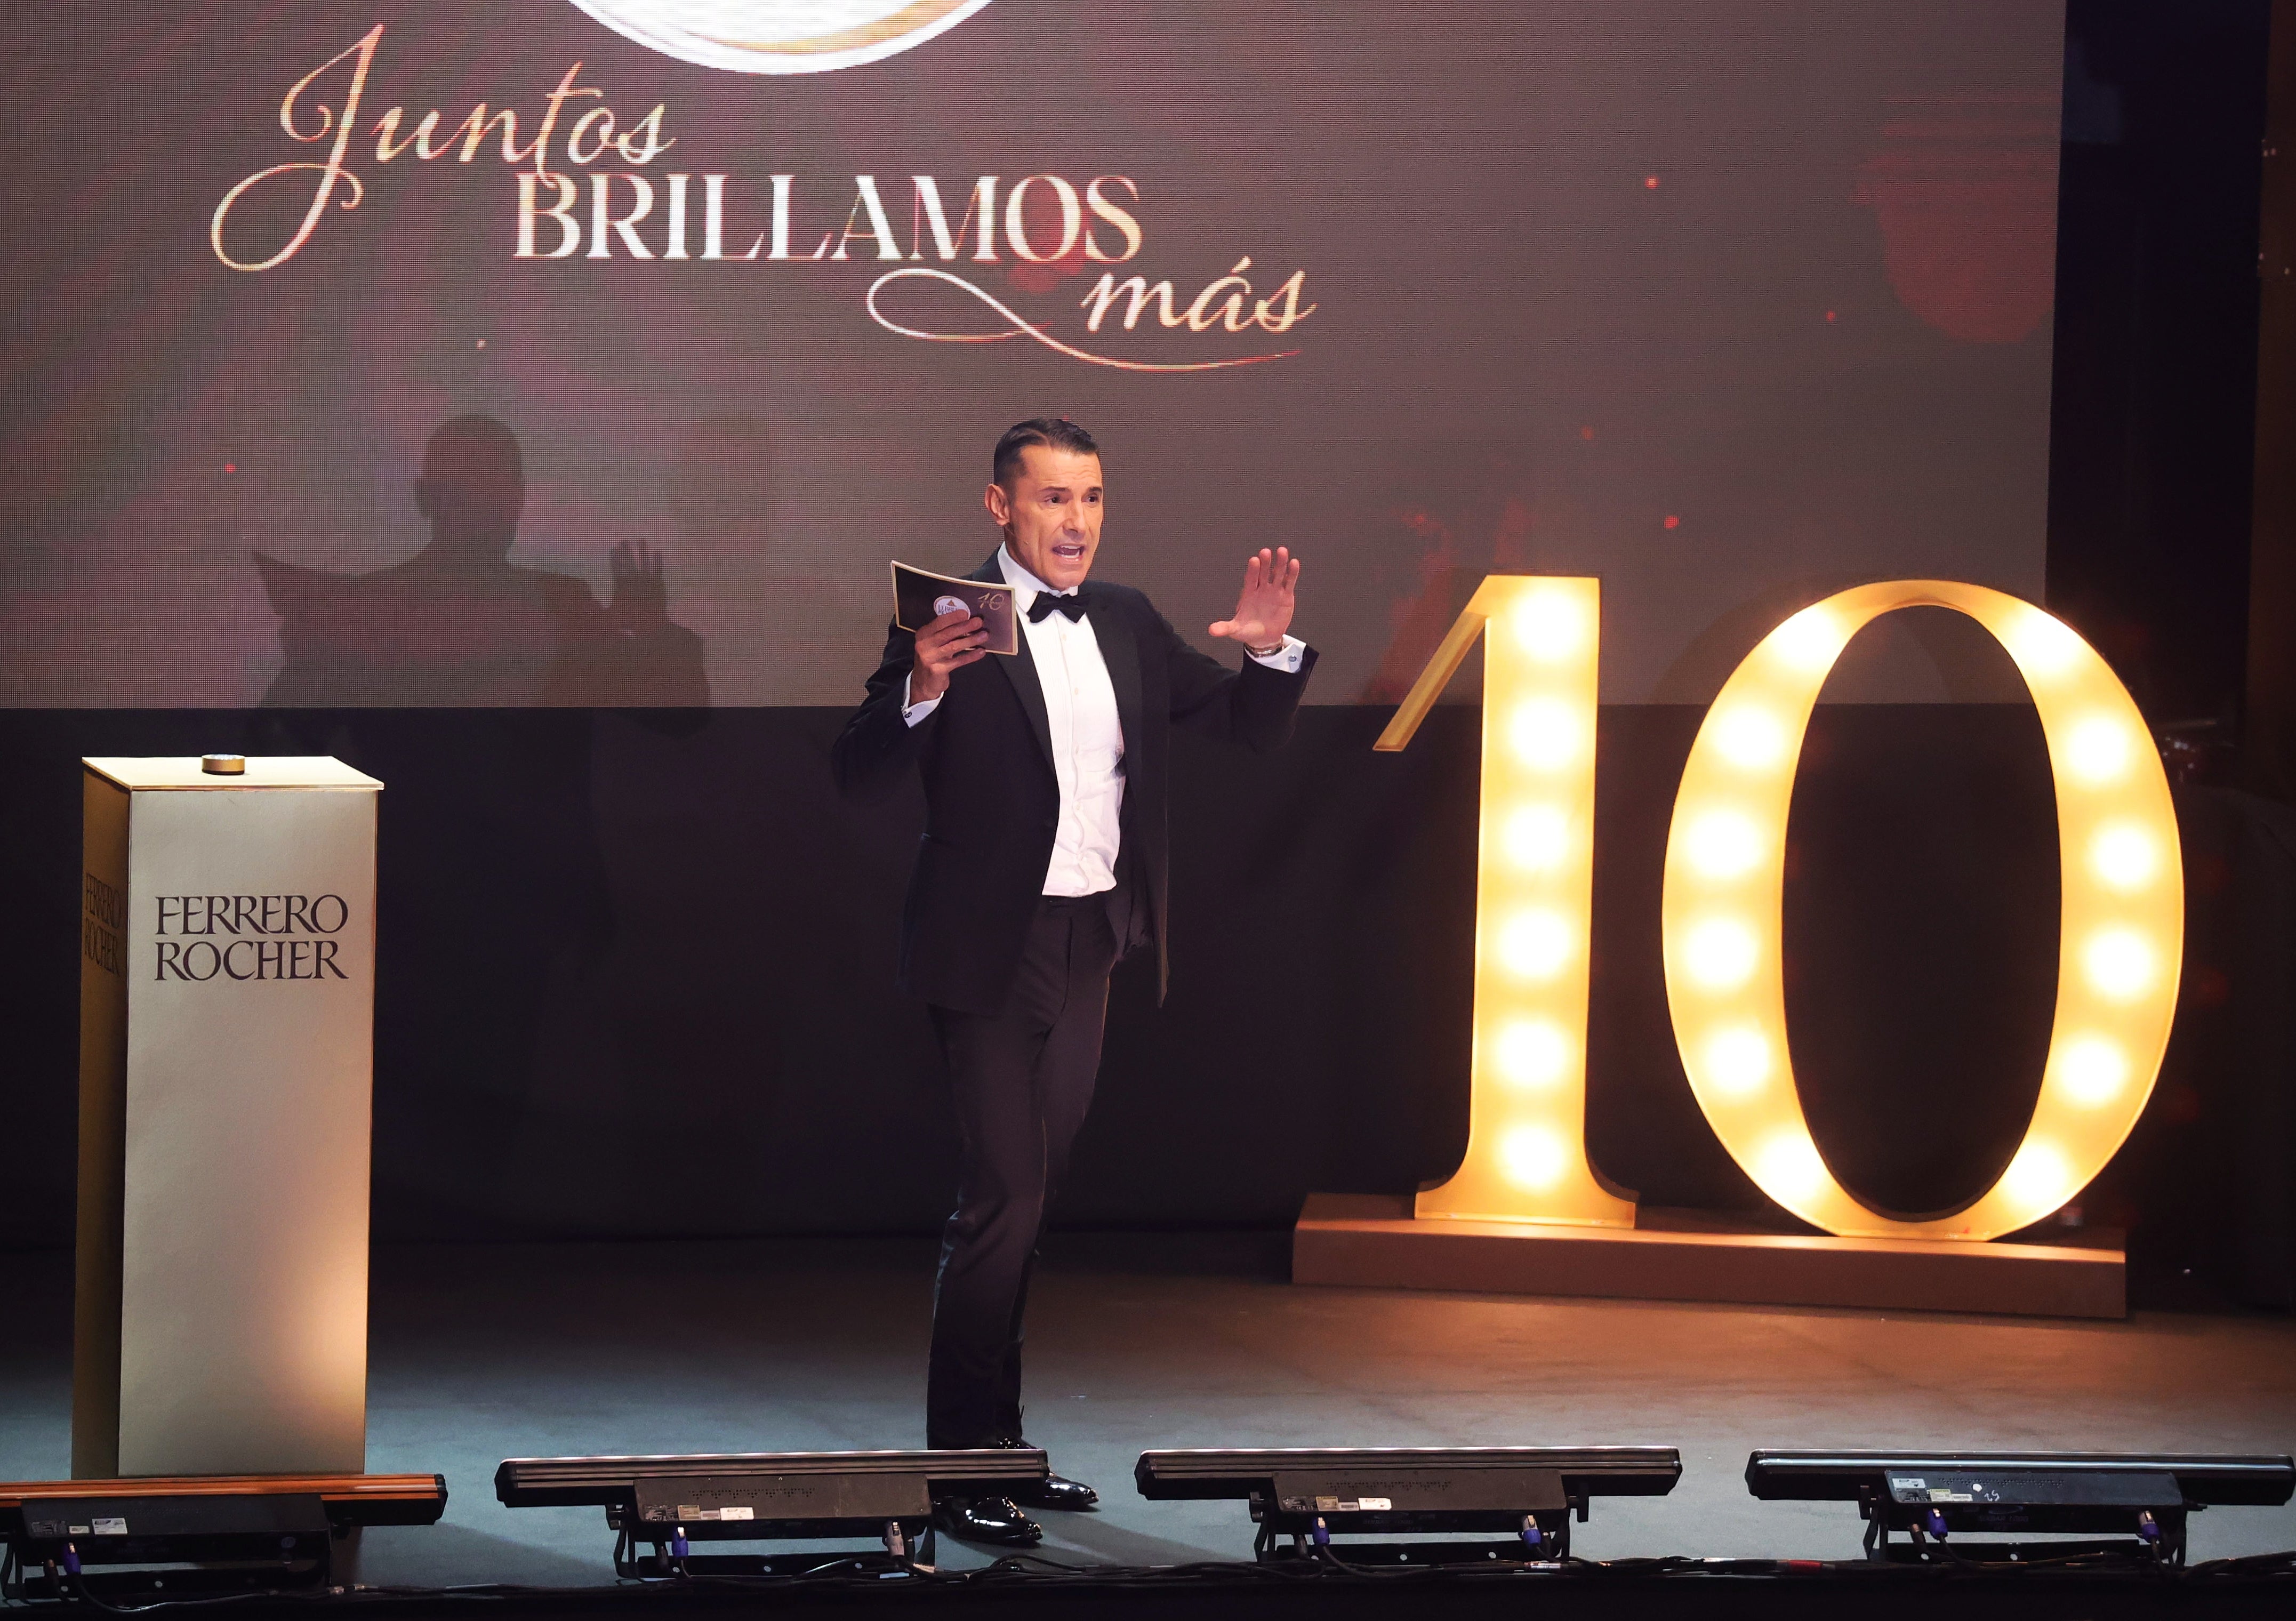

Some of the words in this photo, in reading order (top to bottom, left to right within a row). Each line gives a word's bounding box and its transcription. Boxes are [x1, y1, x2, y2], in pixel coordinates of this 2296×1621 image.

[212, 24, 676, 271] Juntos
[513, 173, 1142, 263] BRILLAMOS
[1080, 256, 1318, 332] más
[977, 592, 1005, 611] 10
[154, 894, 349, 935] FERRERO
[1372, 574, 2185, 1242] 10
[154, 941, 349, 982] ROCHER
